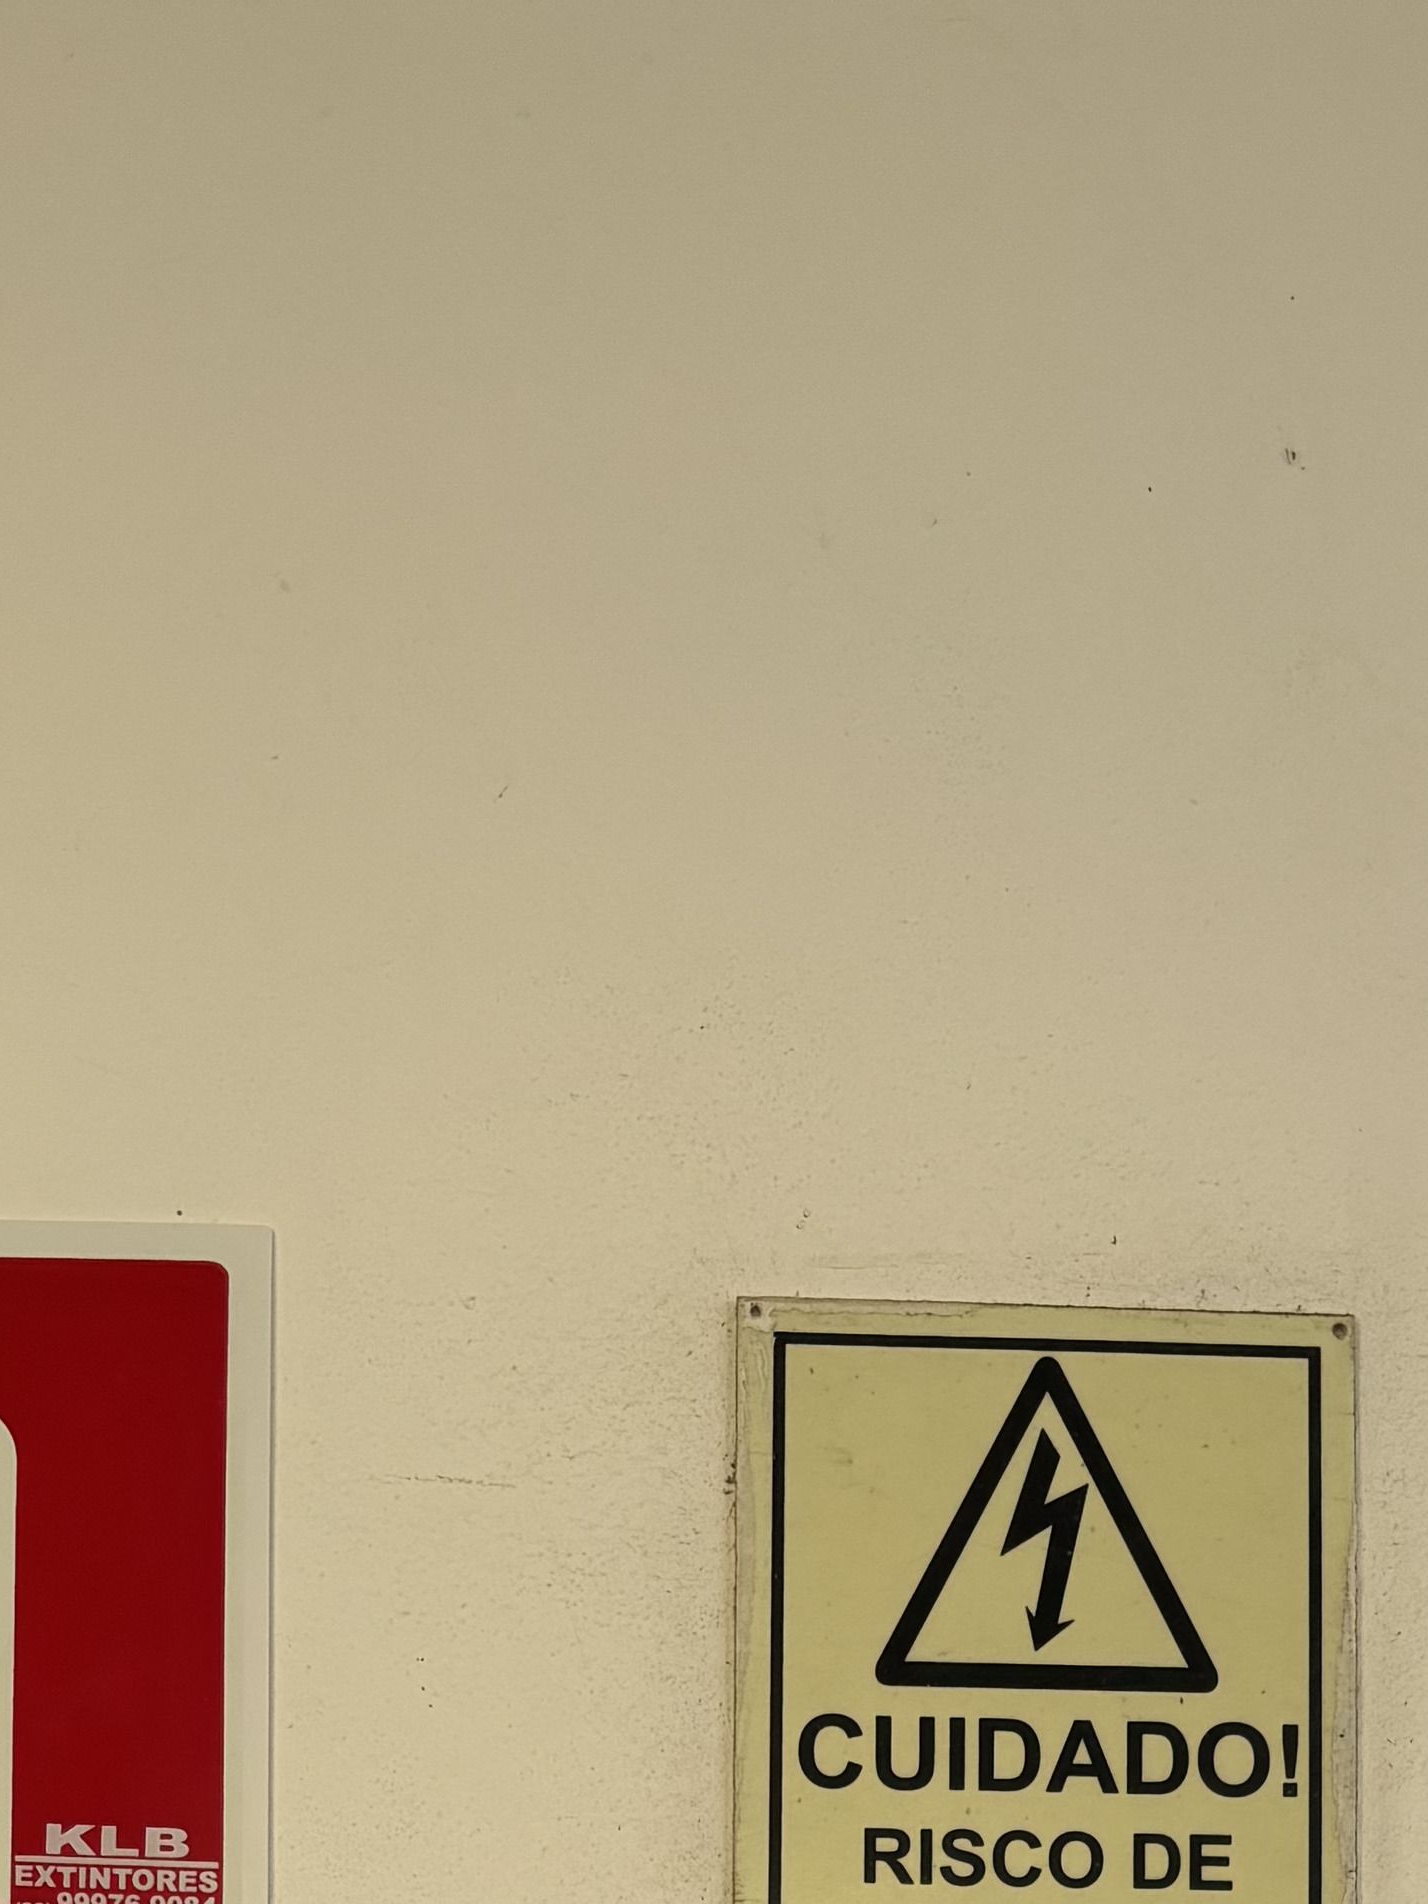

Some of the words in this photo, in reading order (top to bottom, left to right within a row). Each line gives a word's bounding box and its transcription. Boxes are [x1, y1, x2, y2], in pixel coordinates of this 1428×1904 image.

[796, 1713, 1300, 1798] CUIDADO!
[45, 1823, 189, 1858] KLB
[863, 1827, 1104, 1889] RISCO
[1132, 1833, 1234, 1892] DE
[15, 1865, 218, 1893] EXTINTORES
